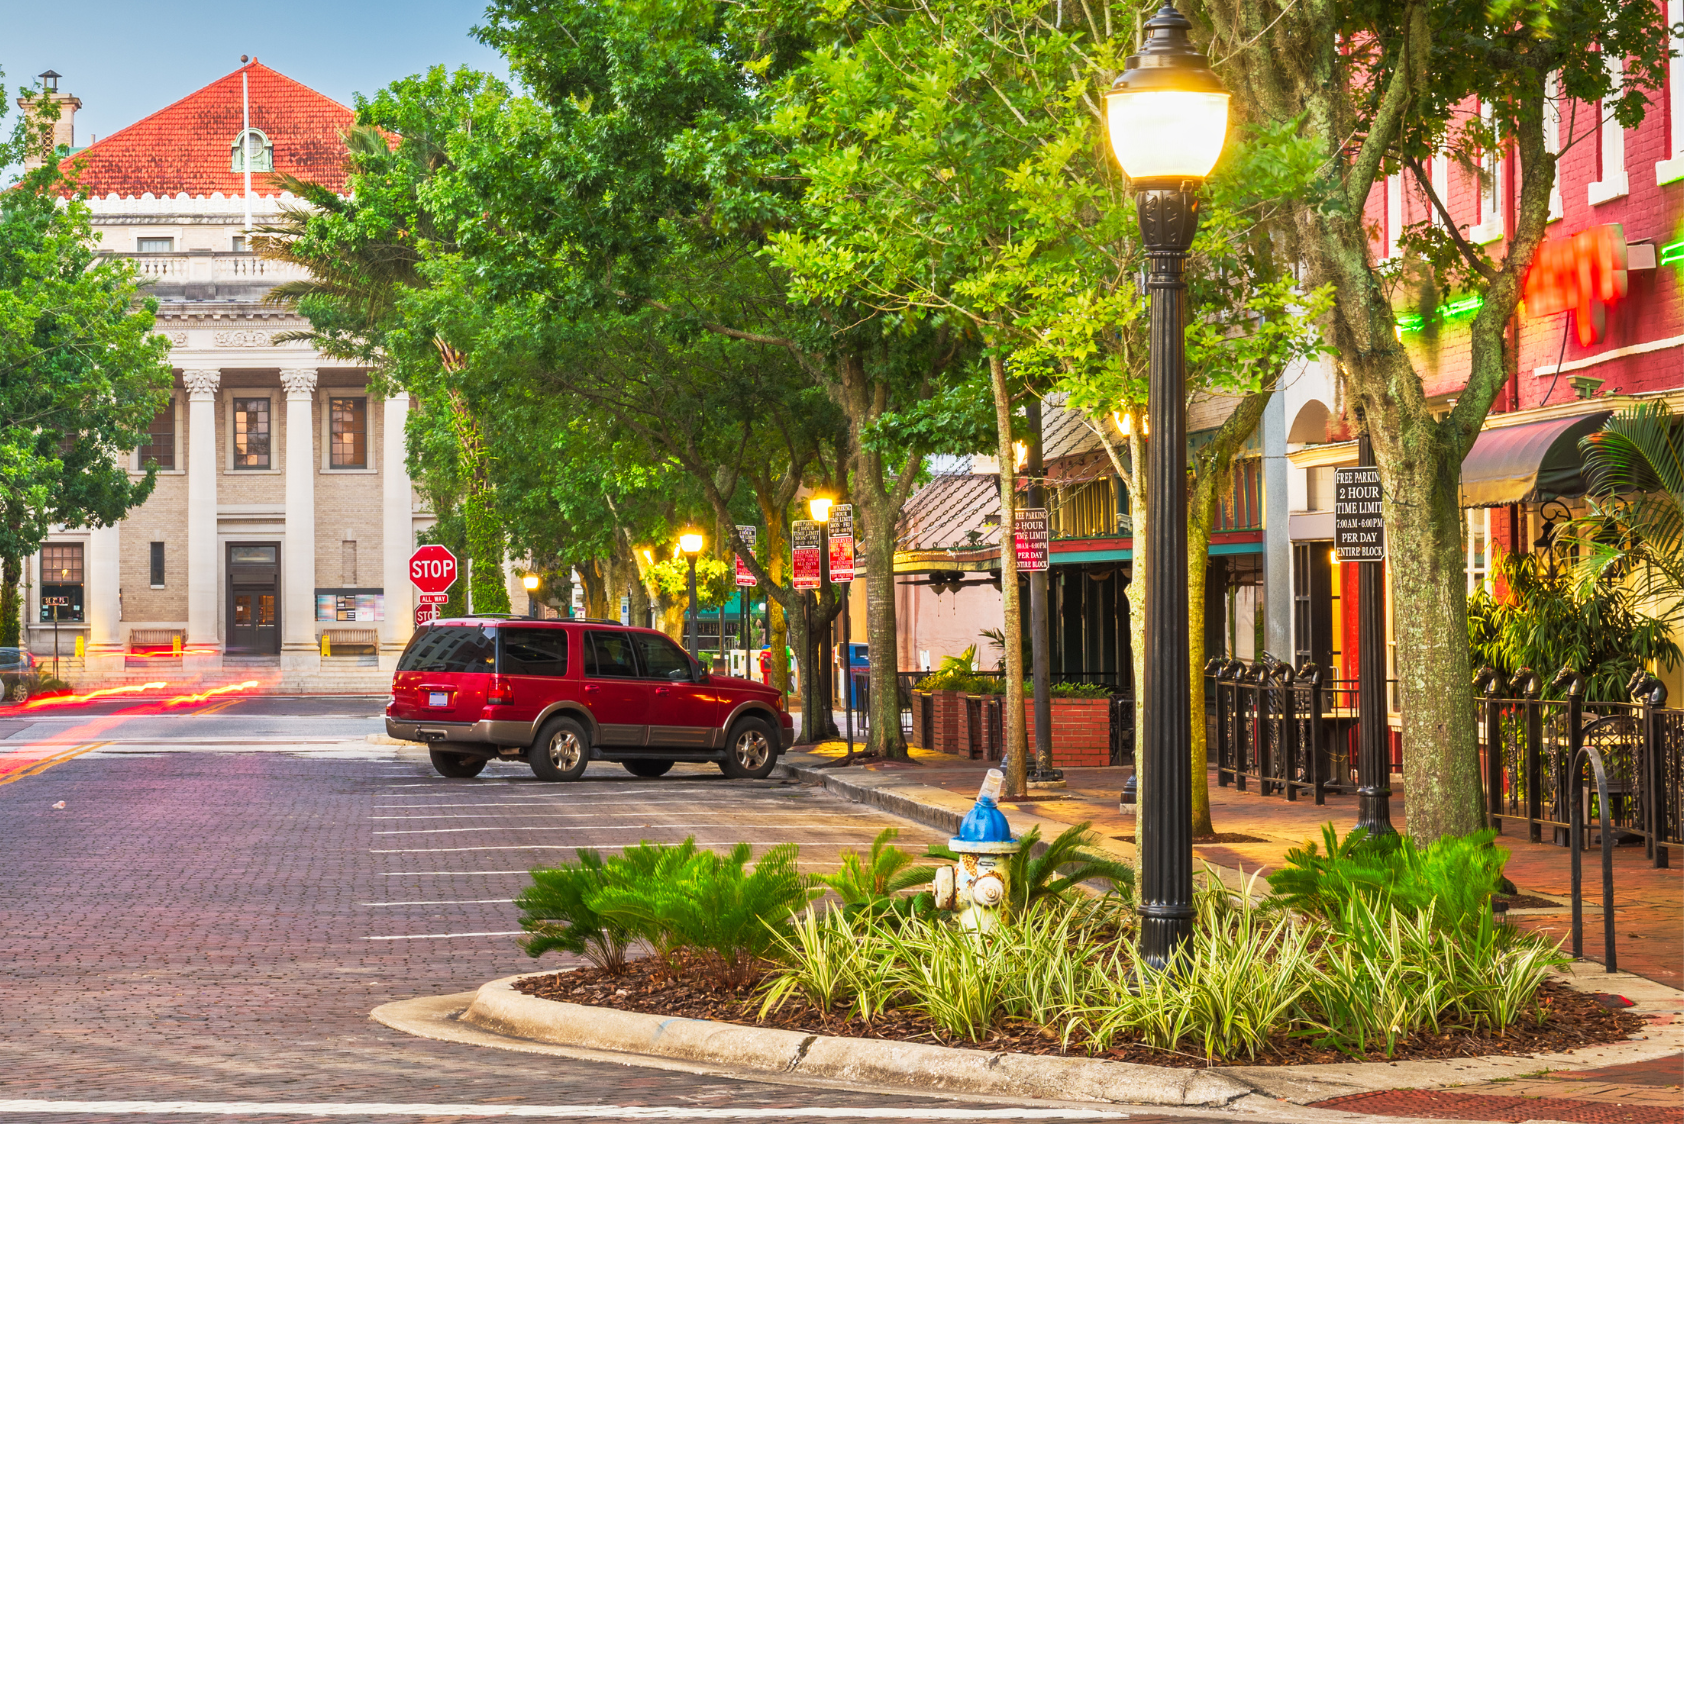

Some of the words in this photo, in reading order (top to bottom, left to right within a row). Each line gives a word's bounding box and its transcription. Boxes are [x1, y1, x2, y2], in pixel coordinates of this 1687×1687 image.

[1336, 473, 1353, 484] FREE
[1354, 472, 1381, 483] PARKIN
[1339, 487, 1346, 499] 2
[1348, 486, 1380, 499] HOUR
[1336, 502, 1357, 514] TIME
[1359, 501, 1383, 514] LIMIT
[1015, 512, 1025, 520] REE
[1025, 511, 1047, 520] PARKING
[1021, 521, 1044, 530] HOUR
[1029, 531, 1047, 539] LIMIT
[1342, 532, 1359, 543] PER
[1359, 532, 1378, 543] DAY
[1030, 551, 1043, 559] DAY
[1336, 546, 1360, 557] ENTIRE
[1361, 546, 1383, 556] BLOCK
[412, 560, 453, 578] STOP
[1032, 560, 1048, 568] BLOCK
[417, 610, 441, 622] STOP
